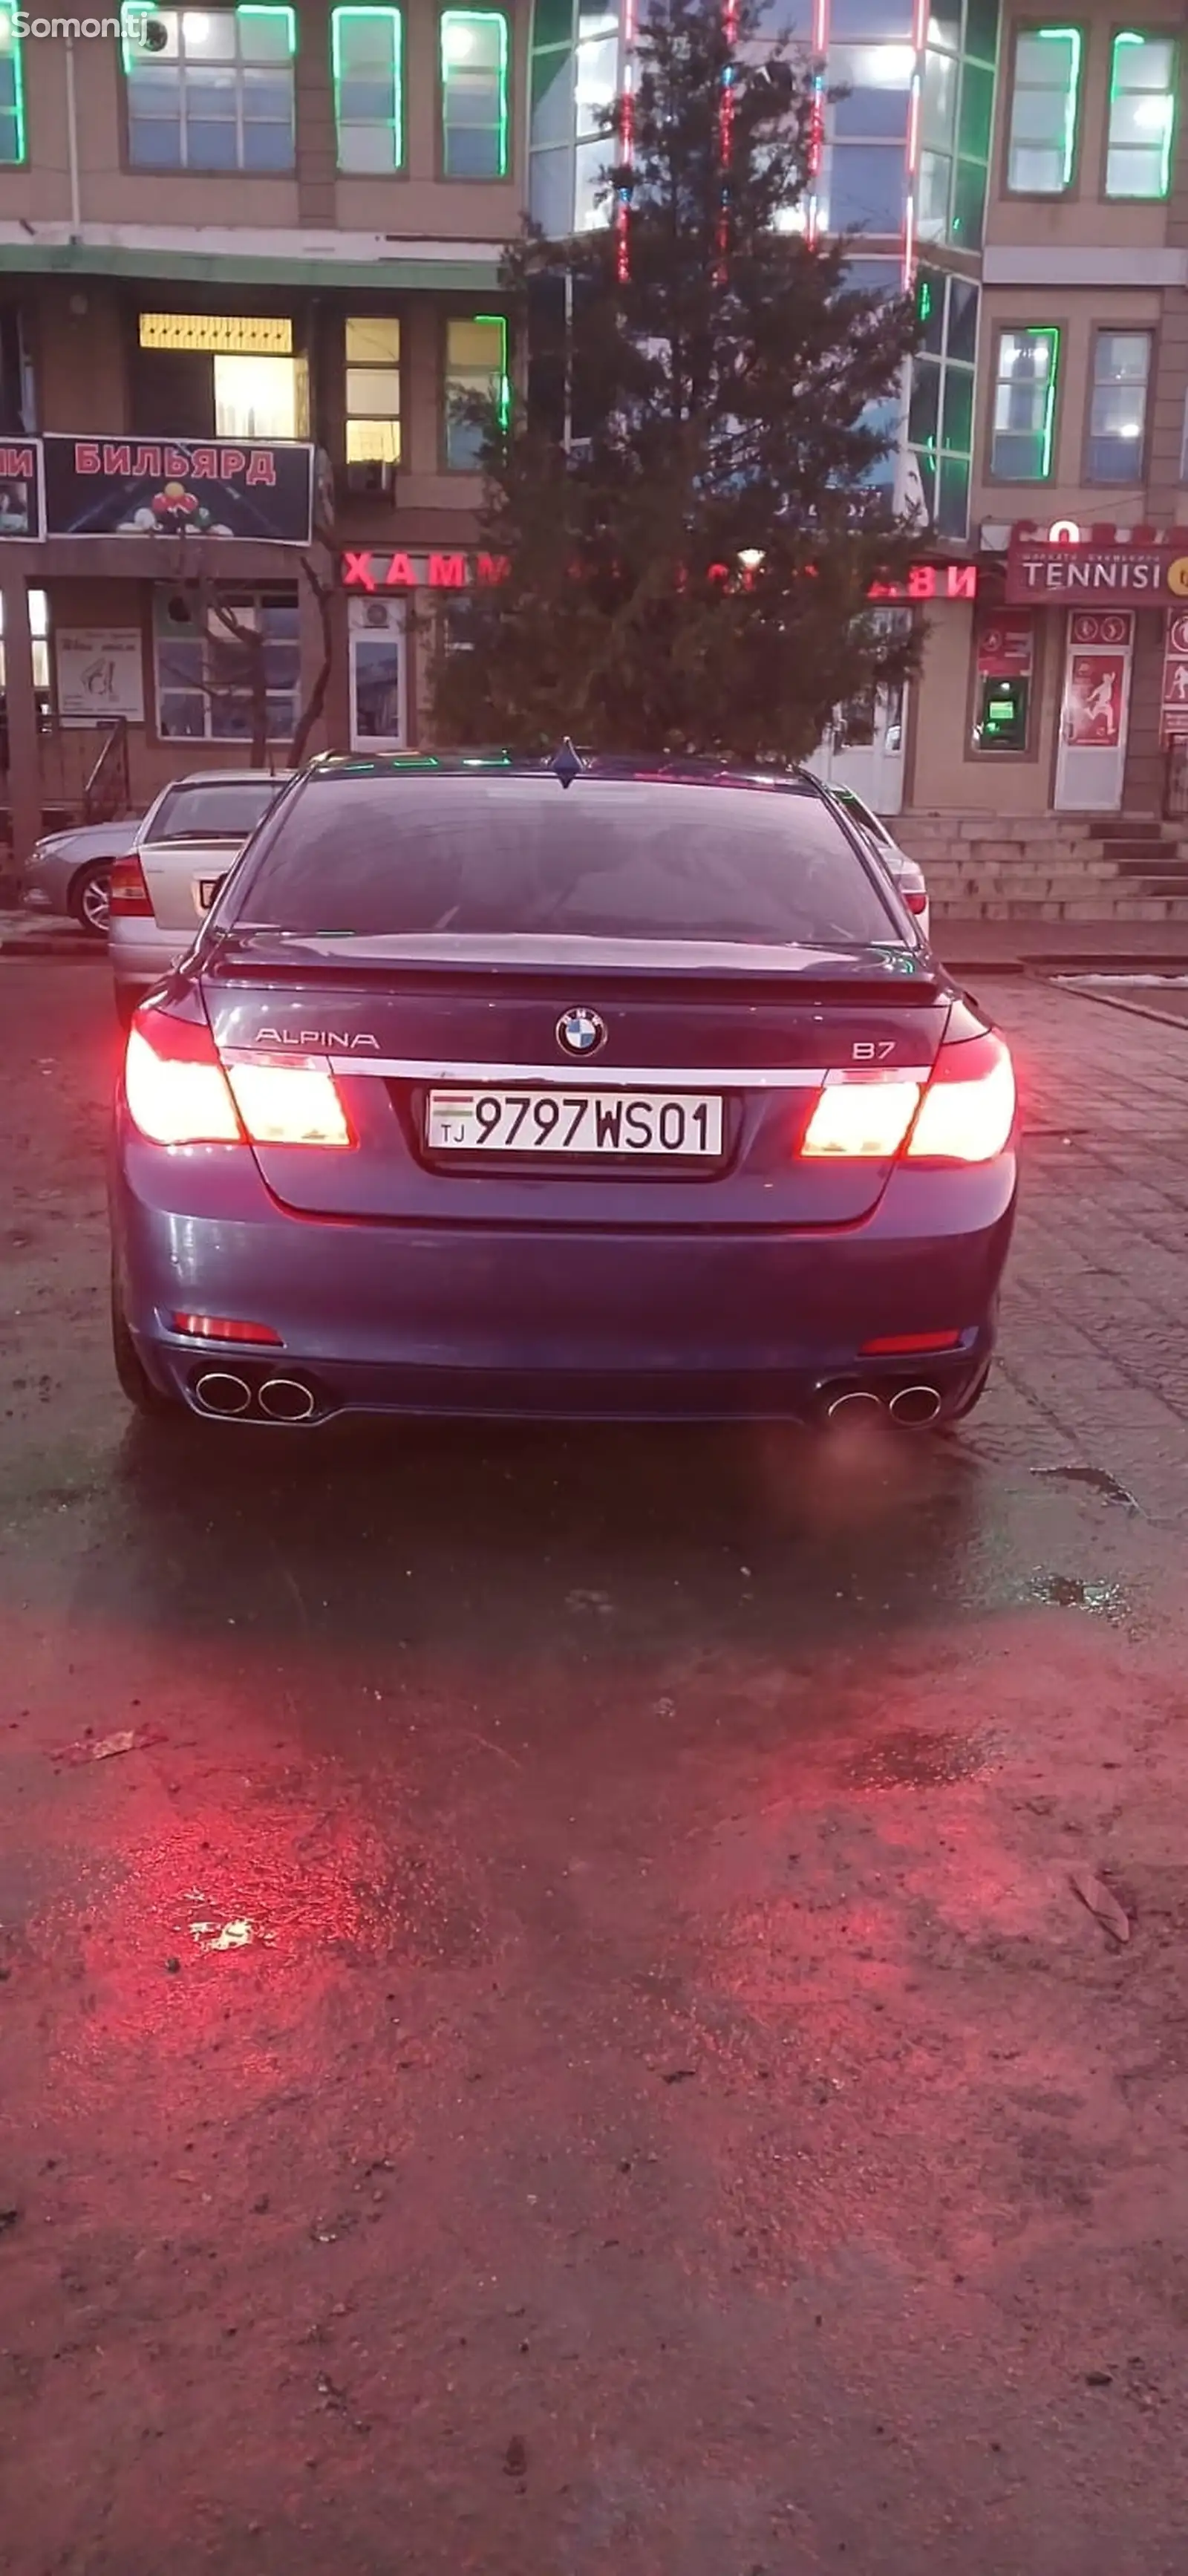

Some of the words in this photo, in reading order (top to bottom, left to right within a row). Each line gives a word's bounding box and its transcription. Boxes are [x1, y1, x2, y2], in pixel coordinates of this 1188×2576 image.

[75, 442, 276, 486] БИЛЬЯРД
[1022, 562, 1160, 589] TENNISI
[255, 1028, 380, 1049] ALPINA
[852, 1042, 895, 1060] B7
[440, 1124, 465, 1143] TJ
[475, 1096, 708, 1150] 9797WS01
